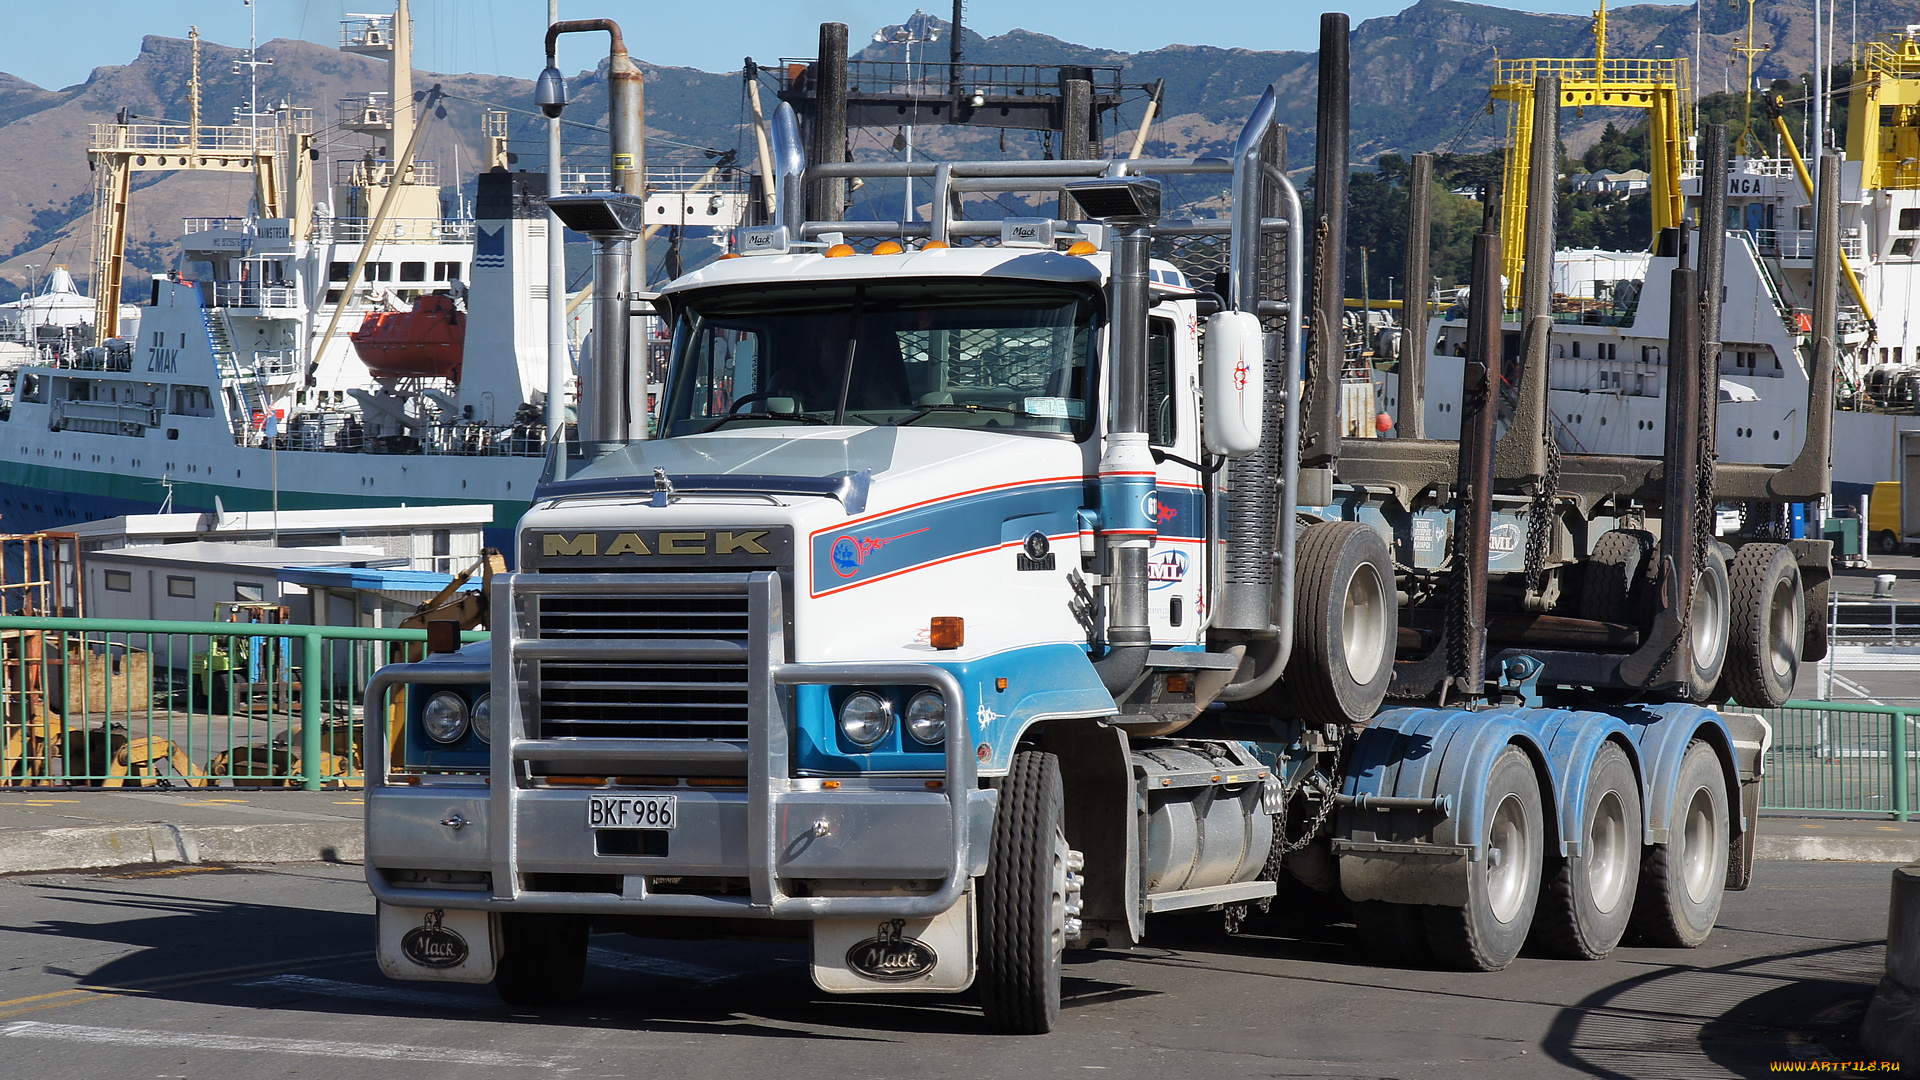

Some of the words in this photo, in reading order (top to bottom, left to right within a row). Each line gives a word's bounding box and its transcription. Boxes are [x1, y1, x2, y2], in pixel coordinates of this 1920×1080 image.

[258, 227, 289, 239] MAINSTREAM
[748, 235, 771, 244] Mack
[1012, 226, 1036, 236] Mack
[147, 348, 178, 373] ZMAK
[543, 531, 771, 556] MACK
[1489, 536, 1514, 552] ML
[1148, 563, 1183, 581] ML
[591, 799, 672, 825] BKF986
[415, 937, 457, 957] Mack
[864, 948, 921, 968] Mack
